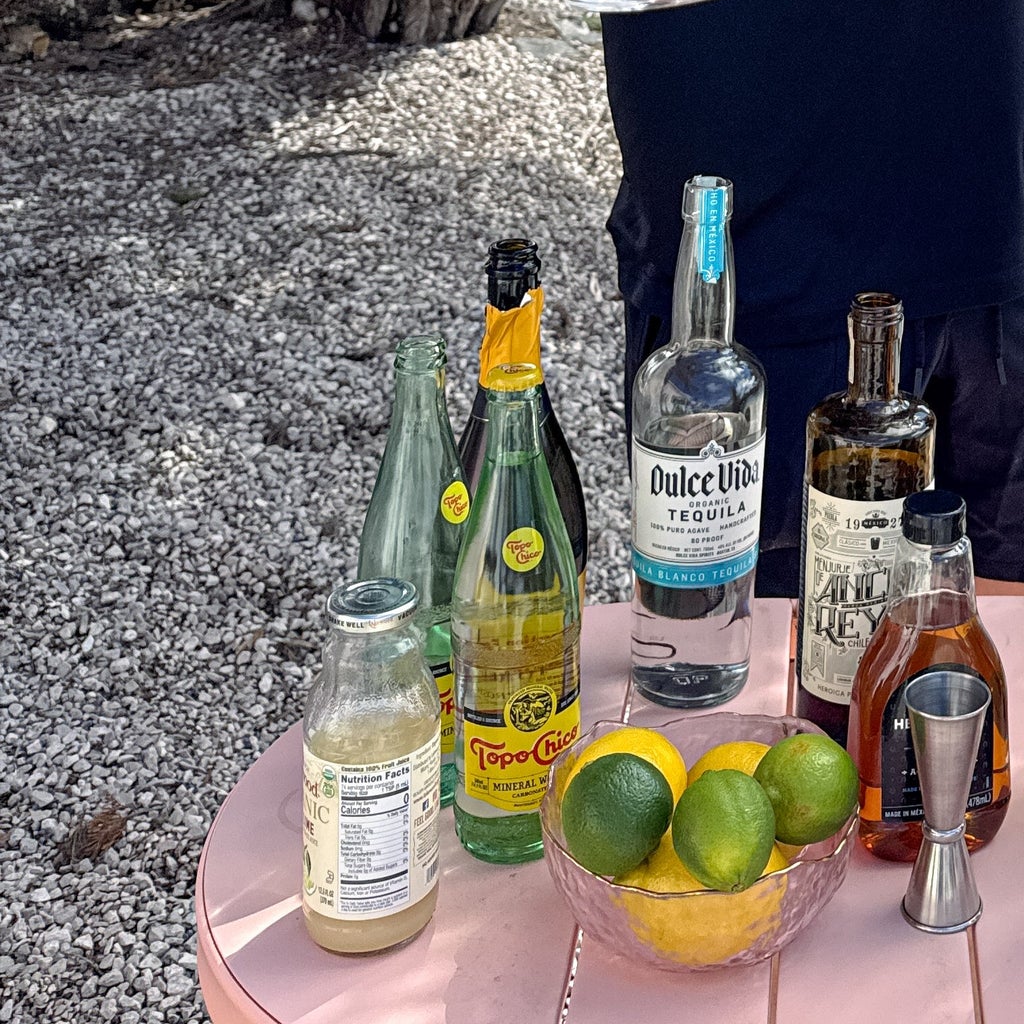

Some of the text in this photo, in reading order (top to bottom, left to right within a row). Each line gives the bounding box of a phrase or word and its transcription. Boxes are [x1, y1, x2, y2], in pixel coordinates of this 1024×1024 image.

[710, 187, 718, 206] HO
[710, 209, 718, 222] EN
[650, 458, 760, 498] Dulce Vida
[443, 493, 463, 509] Topo
[452, 500, 468, 517] Chico
[688, 497, 730, 508] ORGANIC
[667, 501, 747, 524] TEQUILA
[666, 526, 686, 534] PURO
[686, 526, 711, 535] AGAVE
[845, 517, 861, 531] 19
[505, 539, 534, 555] Topo
[515, 549, 542, 565] Chico
[658, 569, 706, 582] BLANCO
[712, 556, 753, 580] TEQUILA
[815, 566, 891, 605] ANC
[469, 736, 531, 771] Topo
[531, 722, 580, 766] Chico
[340, 766, 410, 784] Nutrition Facts
[493, 779, 537, 791] MINERAL
[340, 792, 410, 815] Calories 0
[884, 810, 902, 818] MADE
[910, 808, 925, 816] MÉX
